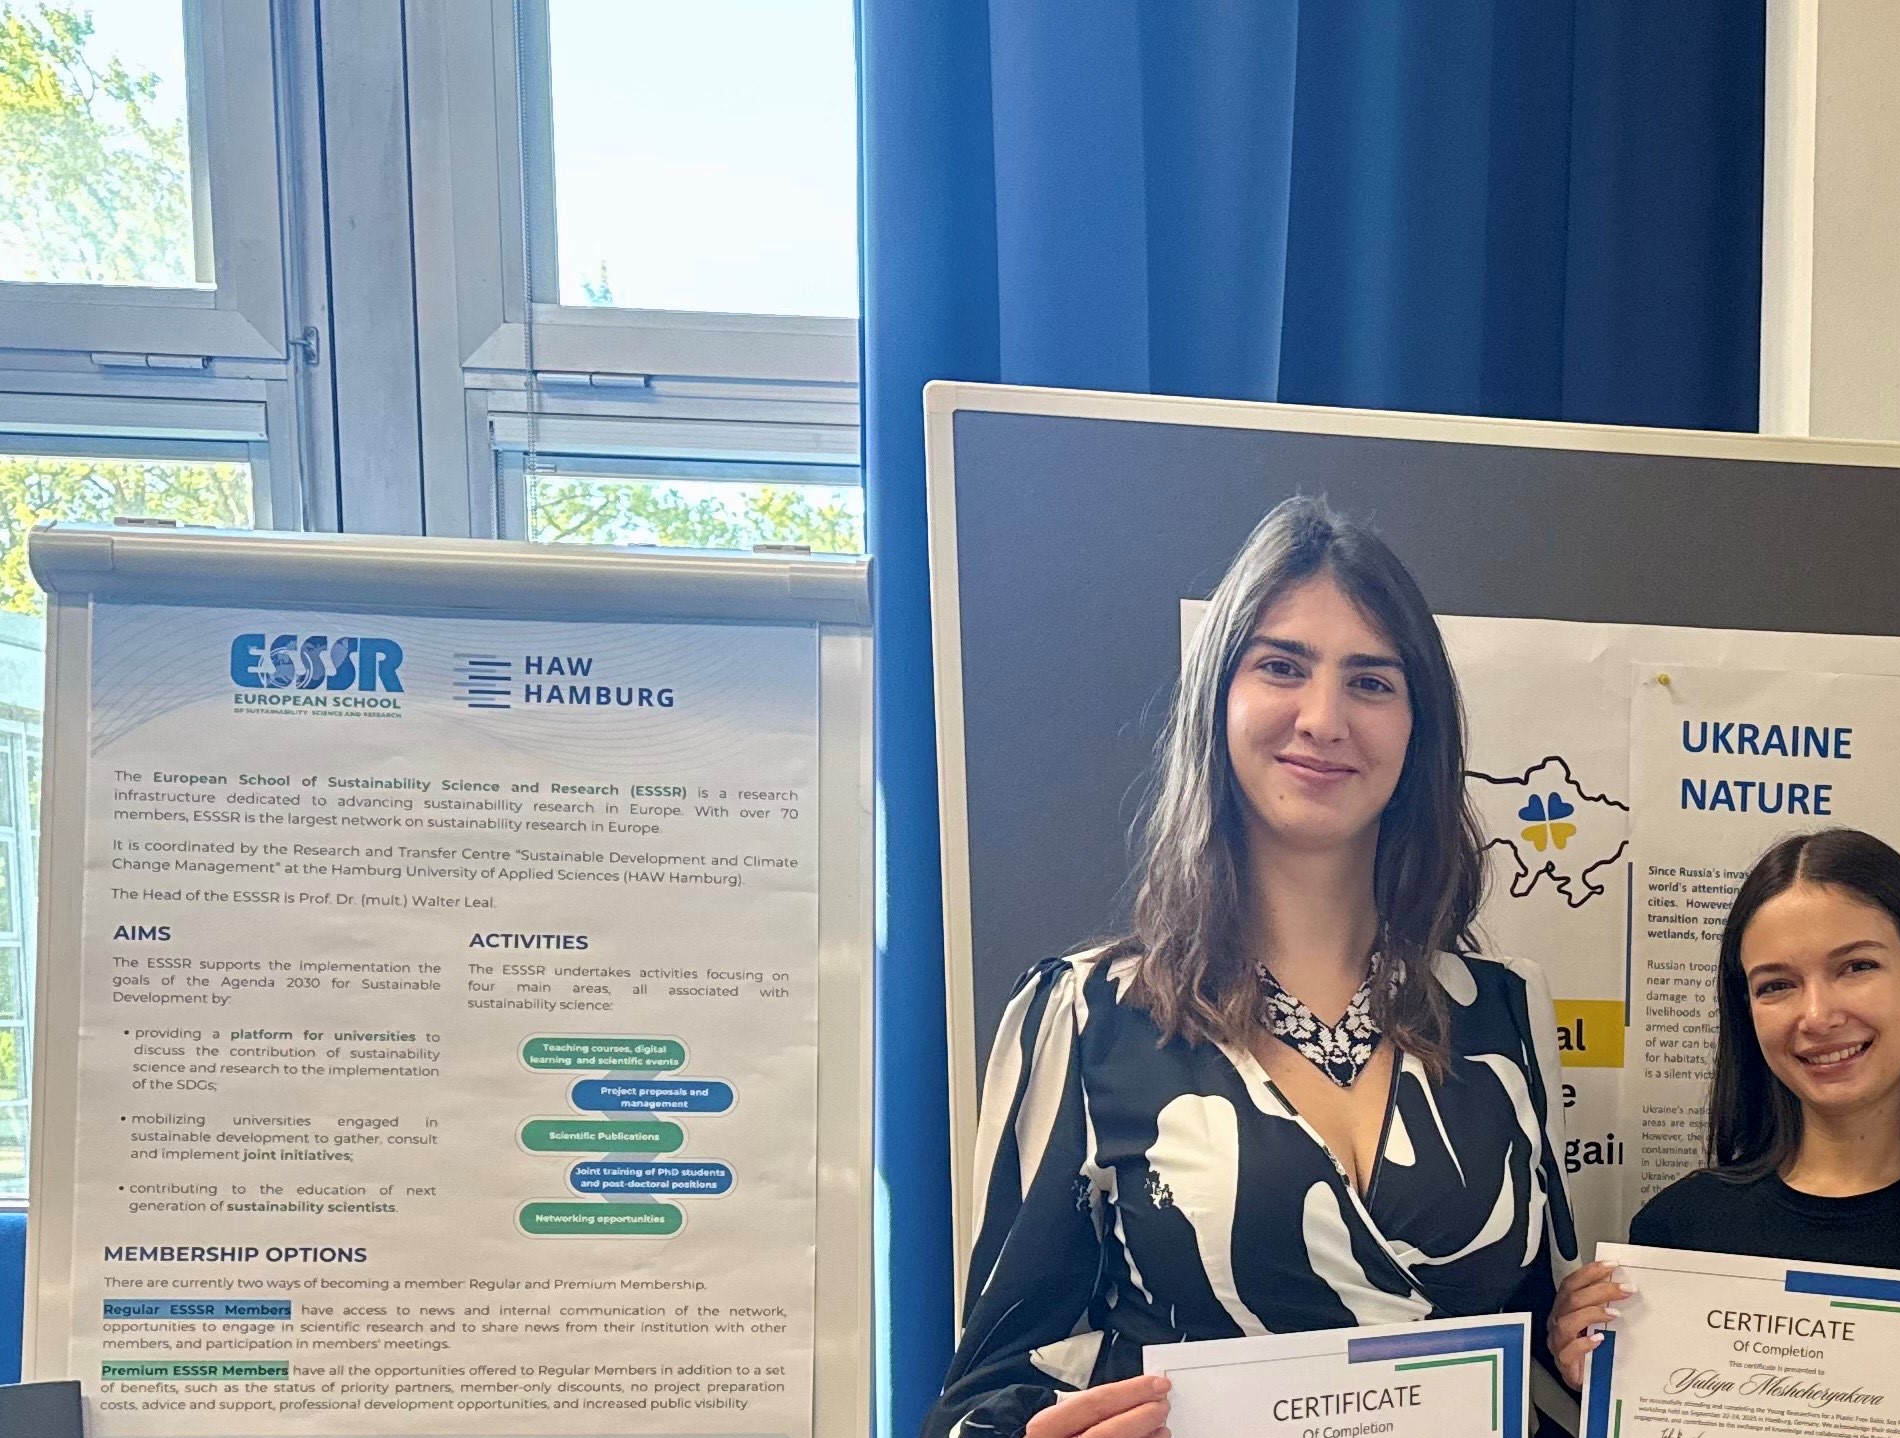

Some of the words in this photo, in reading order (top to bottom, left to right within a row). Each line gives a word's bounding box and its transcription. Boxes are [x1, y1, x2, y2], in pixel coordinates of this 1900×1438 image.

[230, 633, 405, 693] ESSSR
[525, 655, 592, 676] HAW
[233, 693, 328, 708] EUROPEAN
[332, 696, 401, 709] SCHOOL
[525, 684, 675, 707] HAMBURG
[1682, 720, 1852, 759] UKRAINE
[114, 770, 142, 783] The
[153, 771, 228, 787] European
[239, 773, 290, 787] School
[301, 775, 317, 787] of
[328, 776, 430, 792] Sustainability
[441, 779, 500, 792] Science
[511, 782, 540, 794] and
[551, 783, 619, 796] Research
[630, 784, 687, 800] (ESSSR)
[698, 786, 709, 799] is
[719, 790, 728, 800] a
[738, 788, 798, 801] research
[1680, 778, 1833, 815] NATURE
[1648, 866, 1677, 877] Since
[1679, 867, 1721, 879] Russia's
[1648, 882, 1687, 893] world's
[1648, 914, 1698, 925] transition
[113, 925, 172, 942] AIMS
[469, 933, 589, 950] ACTIVITIES
[1648, 929, 1699, 942] wetlands,
[113, 956, 139, 968] The
[147, 957, 192, 969] ESSSR
[200, 958, 261, 972] supports
[268, 958, 291, 971] the
[300, 960, 411, 975] implementation
[418, 962, 442, 974] the
[1647, 960, 1686, 971] Russian
[112, 974, 150, 988] goals
[161, 975, 176, 986] of
[186, 975, 210, 987] the
[220, 976, 275, 990] Agenda
[286, 977, 321, 989] 2030
[331, 978, 350, 989] for
[361, 978, 441, 991] Sustainable
[1646, 977, 1670, 986] near
[1674, 978, 1702, 988] many
[1646, 992, 1687, 1004] damage
[1694, 994, 1706, 1003] to
[1646, 1007, 1701, 1018] livelihoods
[135, 1027, 202, 1042] providing
[230, 1028, 293, 1044] platform
[303, 1029, 324, 1041] for
[334, 1030, 416, 1043] universities
[1645, 1023, 1679, 1033] armed
[1645, 1038, 1656, 1048] of
[1659, 1040, 1679, 1048] war
[1682, 1040, 1700, 1049] can
[549, 1130, 596, 1142] Scientific
[597, 1131, 660, 1142] Publications
[535, 1213, 595, 1225] Networking
[597, 1214, 666, 1226] opportunities
[104, 1246, 259, 1263] MEMBERSHIP
[266, 1247, 367, 1263] OPTIONS
[104, 1304, 160, 1317] Regular
[170, 1304, 215, 1316] ESSSR
[225, 1304, 291, 1316] Members
[1706, 1309, 1856, 1342] CERTIFICATE
[1733, 1339, 1750, 1353] Of
[1752, 1341, 1824, 1360] Completion
[101, 1364, 169, 1377] Premium
[173, 1364, 218, 1376] ESSSR
[222, 1365, 289, 1376] Members
[1663, 1367, 1736, 1399] Yuliya
[1273, 1384, 1422, 1422] CERTIFICATE
